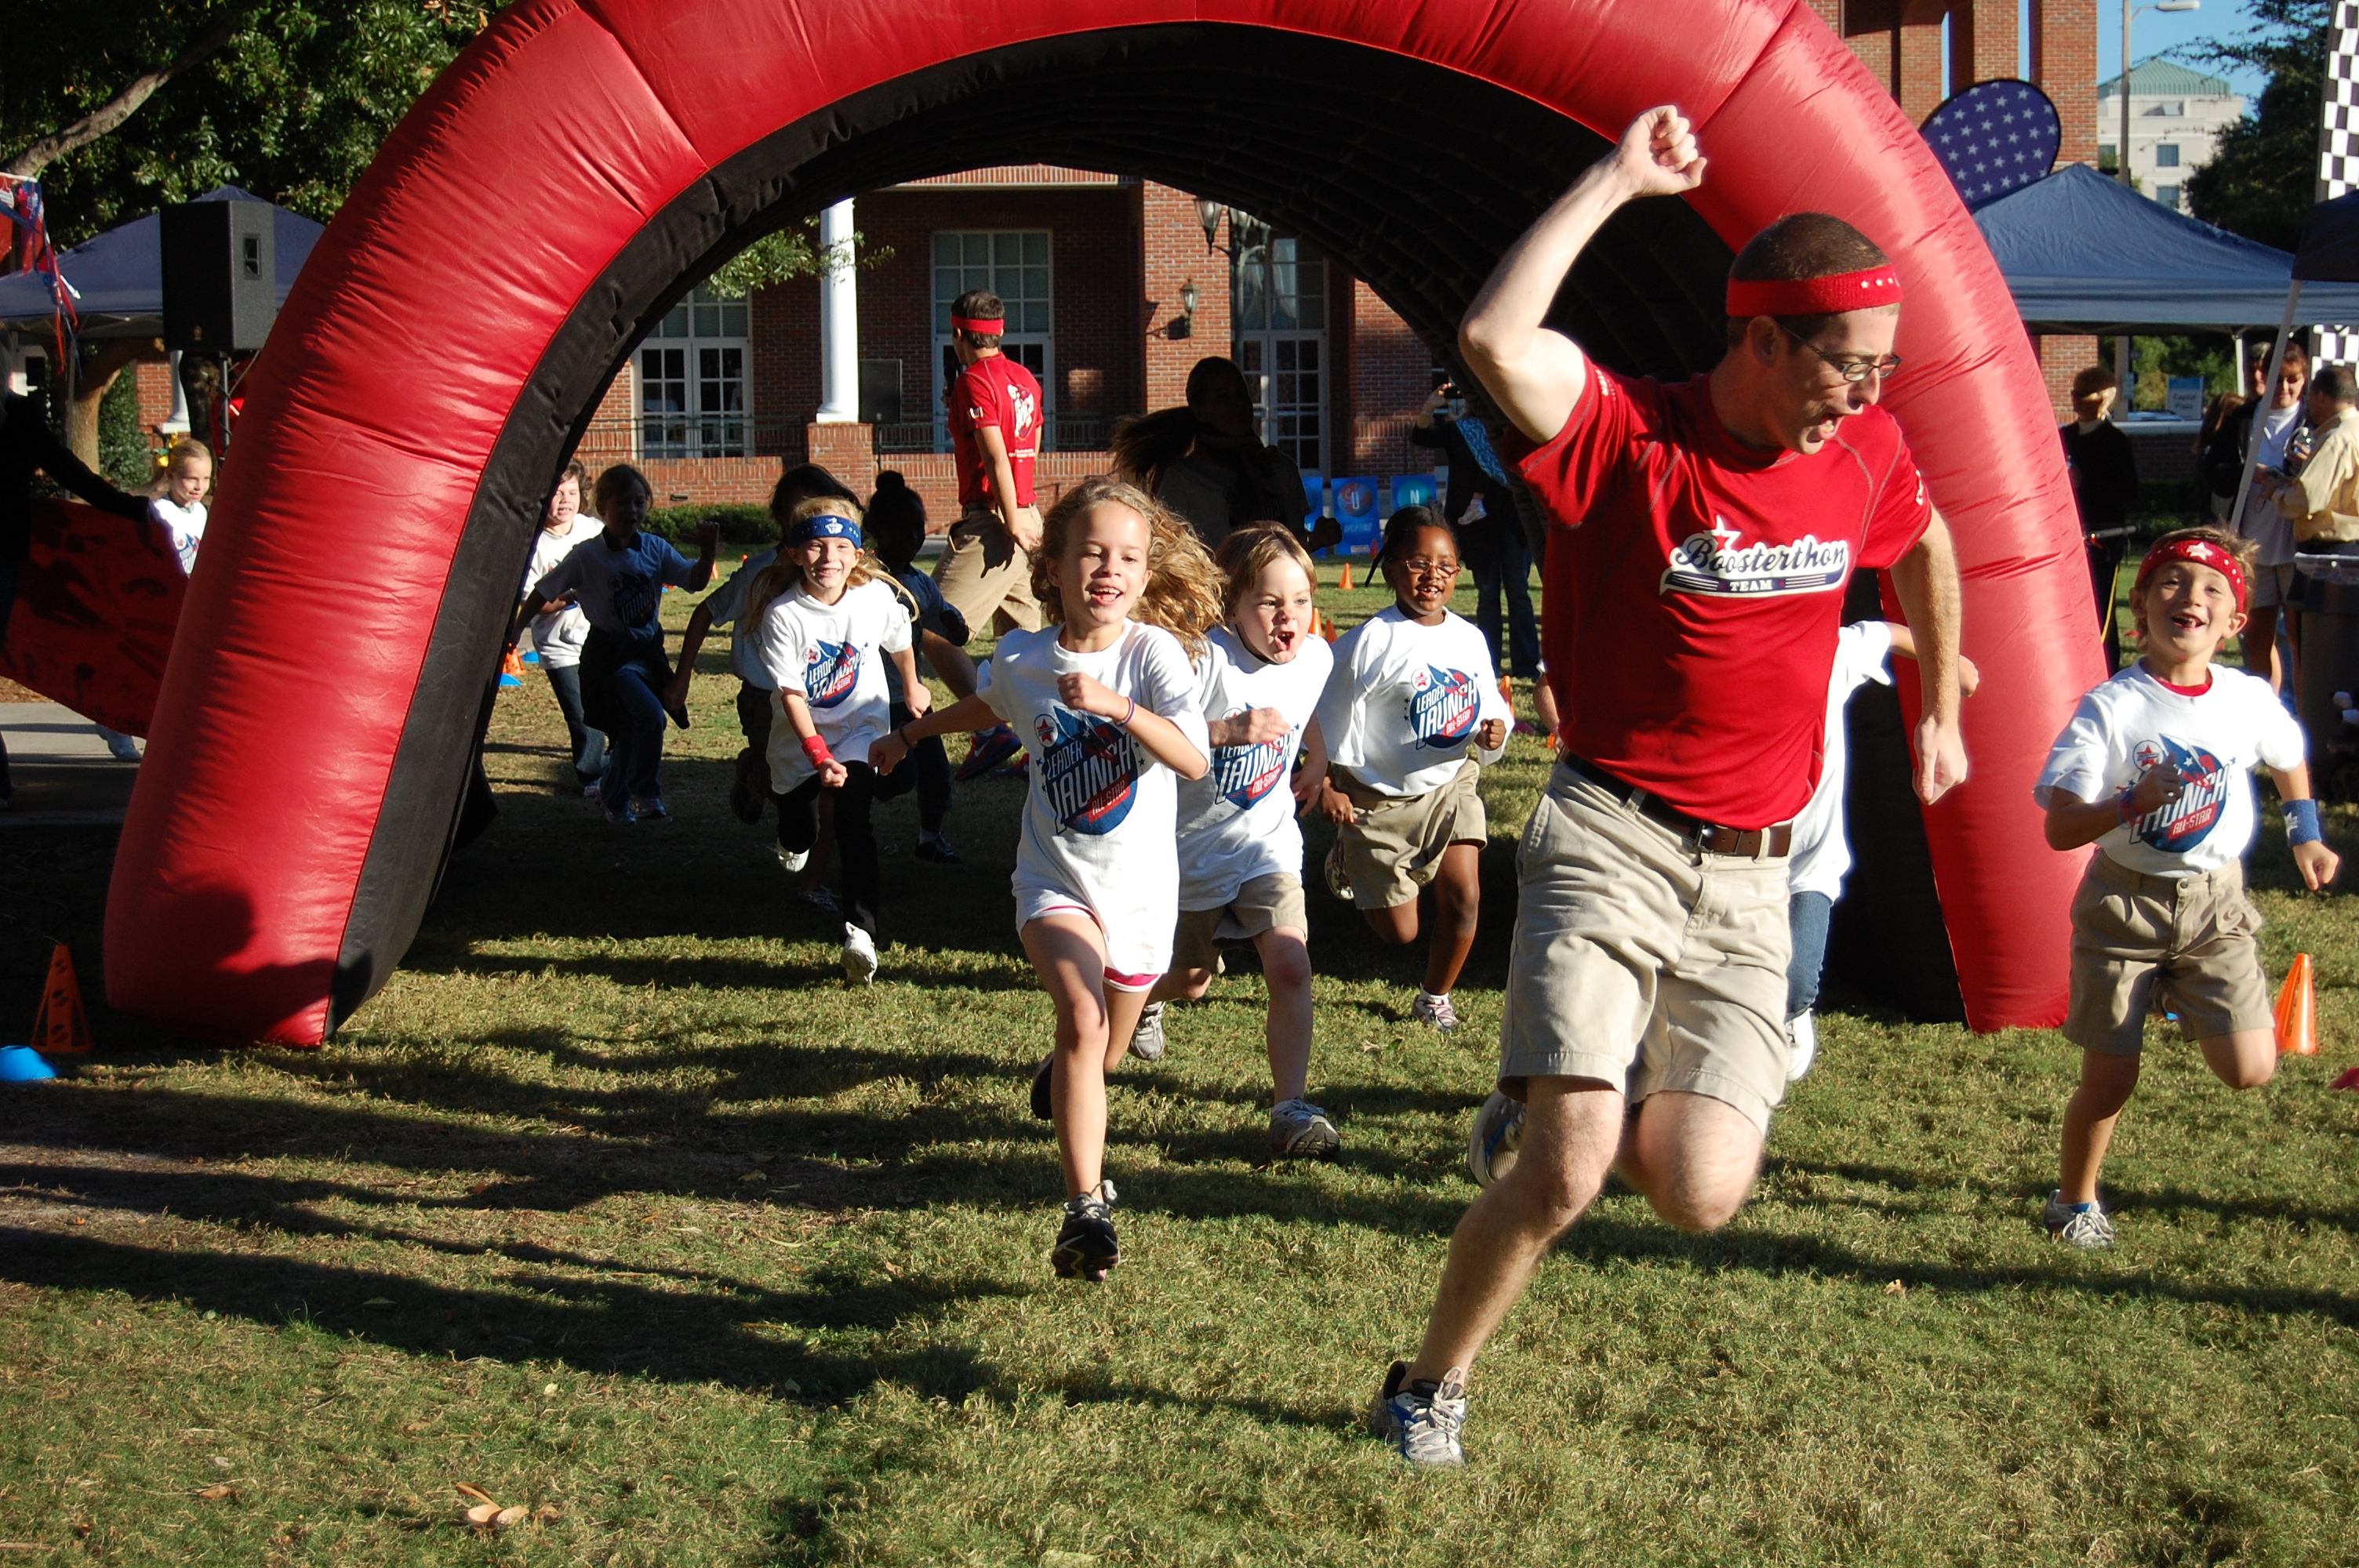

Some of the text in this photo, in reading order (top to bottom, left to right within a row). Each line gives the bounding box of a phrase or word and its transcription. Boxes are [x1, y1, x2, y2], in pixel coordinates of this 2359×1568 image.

[1410, 489, 1420, 505] N
[1675, 537, 1845, 574] Boosterthon
[1729, 579, 1773, 592] TEAM
[1416, 684, 1445, 714] LEADER
[1046, 740, 1084, 781] LEADER
[1092, 780, 1126, 815] ALL-STAR
[2172, 808, 2212, 836] ALL-STAR
